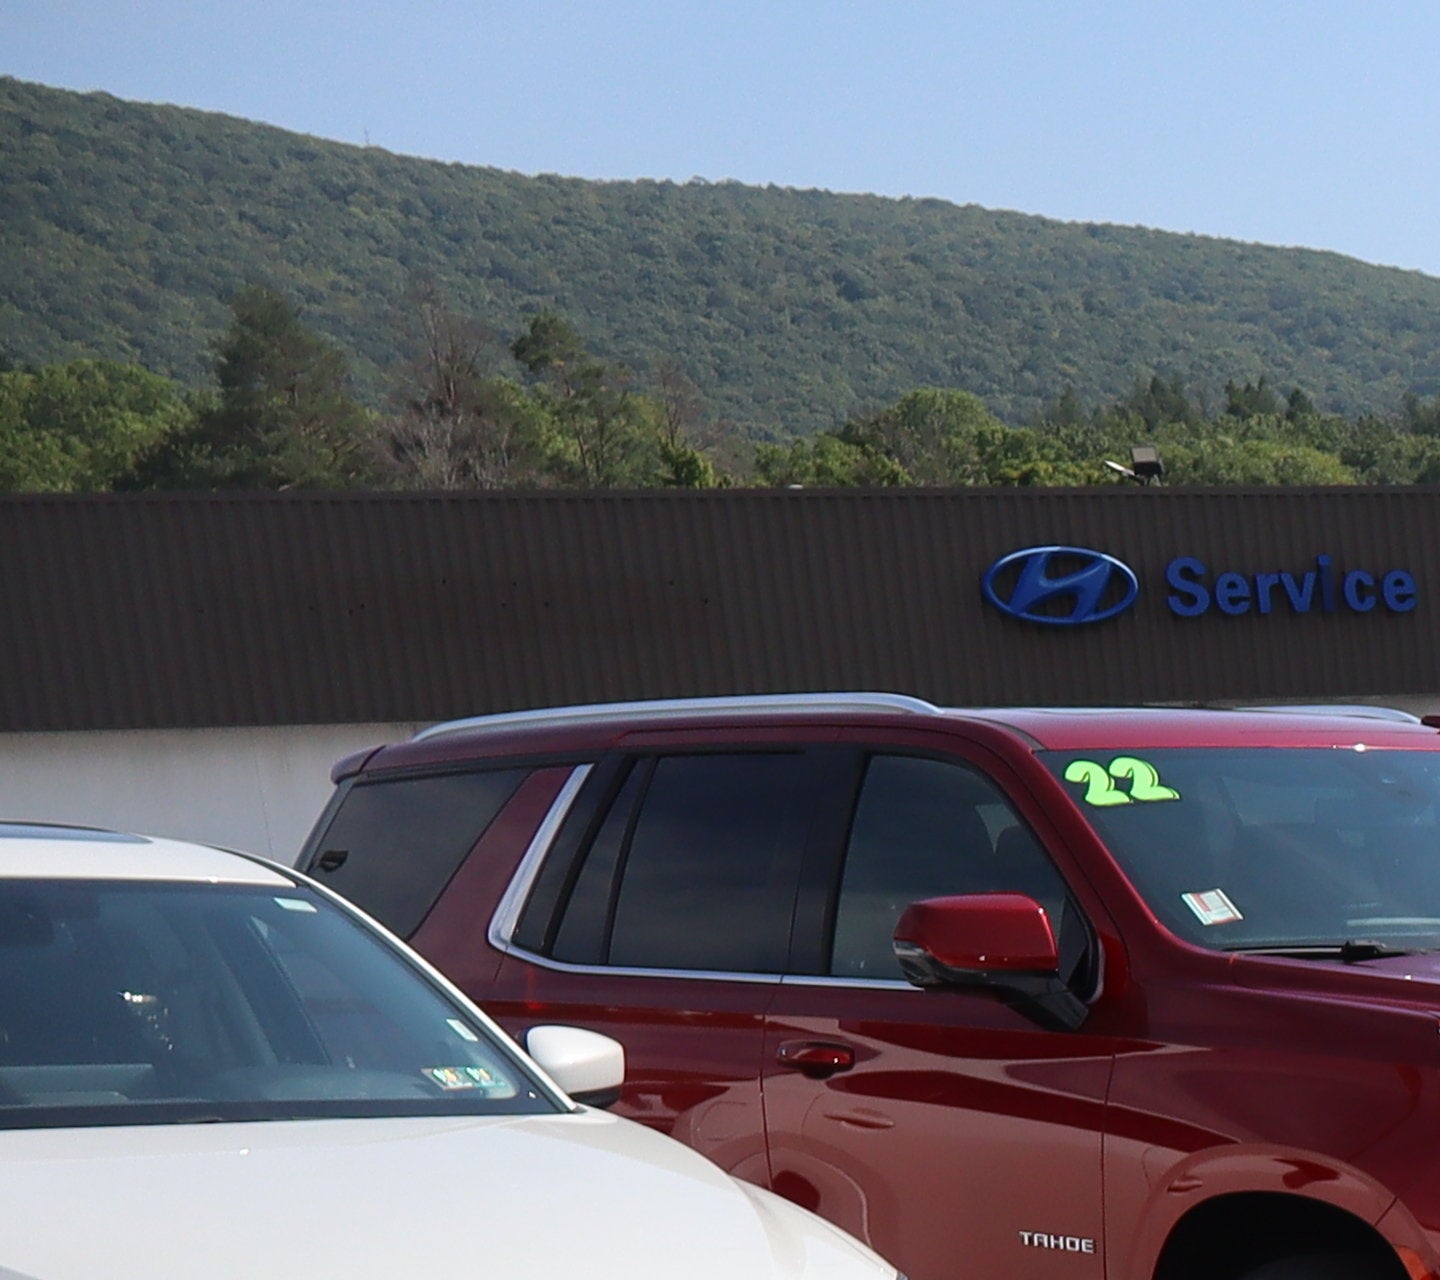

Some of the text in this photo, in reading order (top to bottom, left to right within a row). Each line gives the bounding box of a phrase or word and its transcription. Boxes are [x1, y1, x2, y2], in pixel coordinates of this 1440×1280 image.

[1165, 554, 1418, 617] Service
[1063, 755, 1181, 807] 22
[1018, 1230, 1095, 1254] TAHOE
